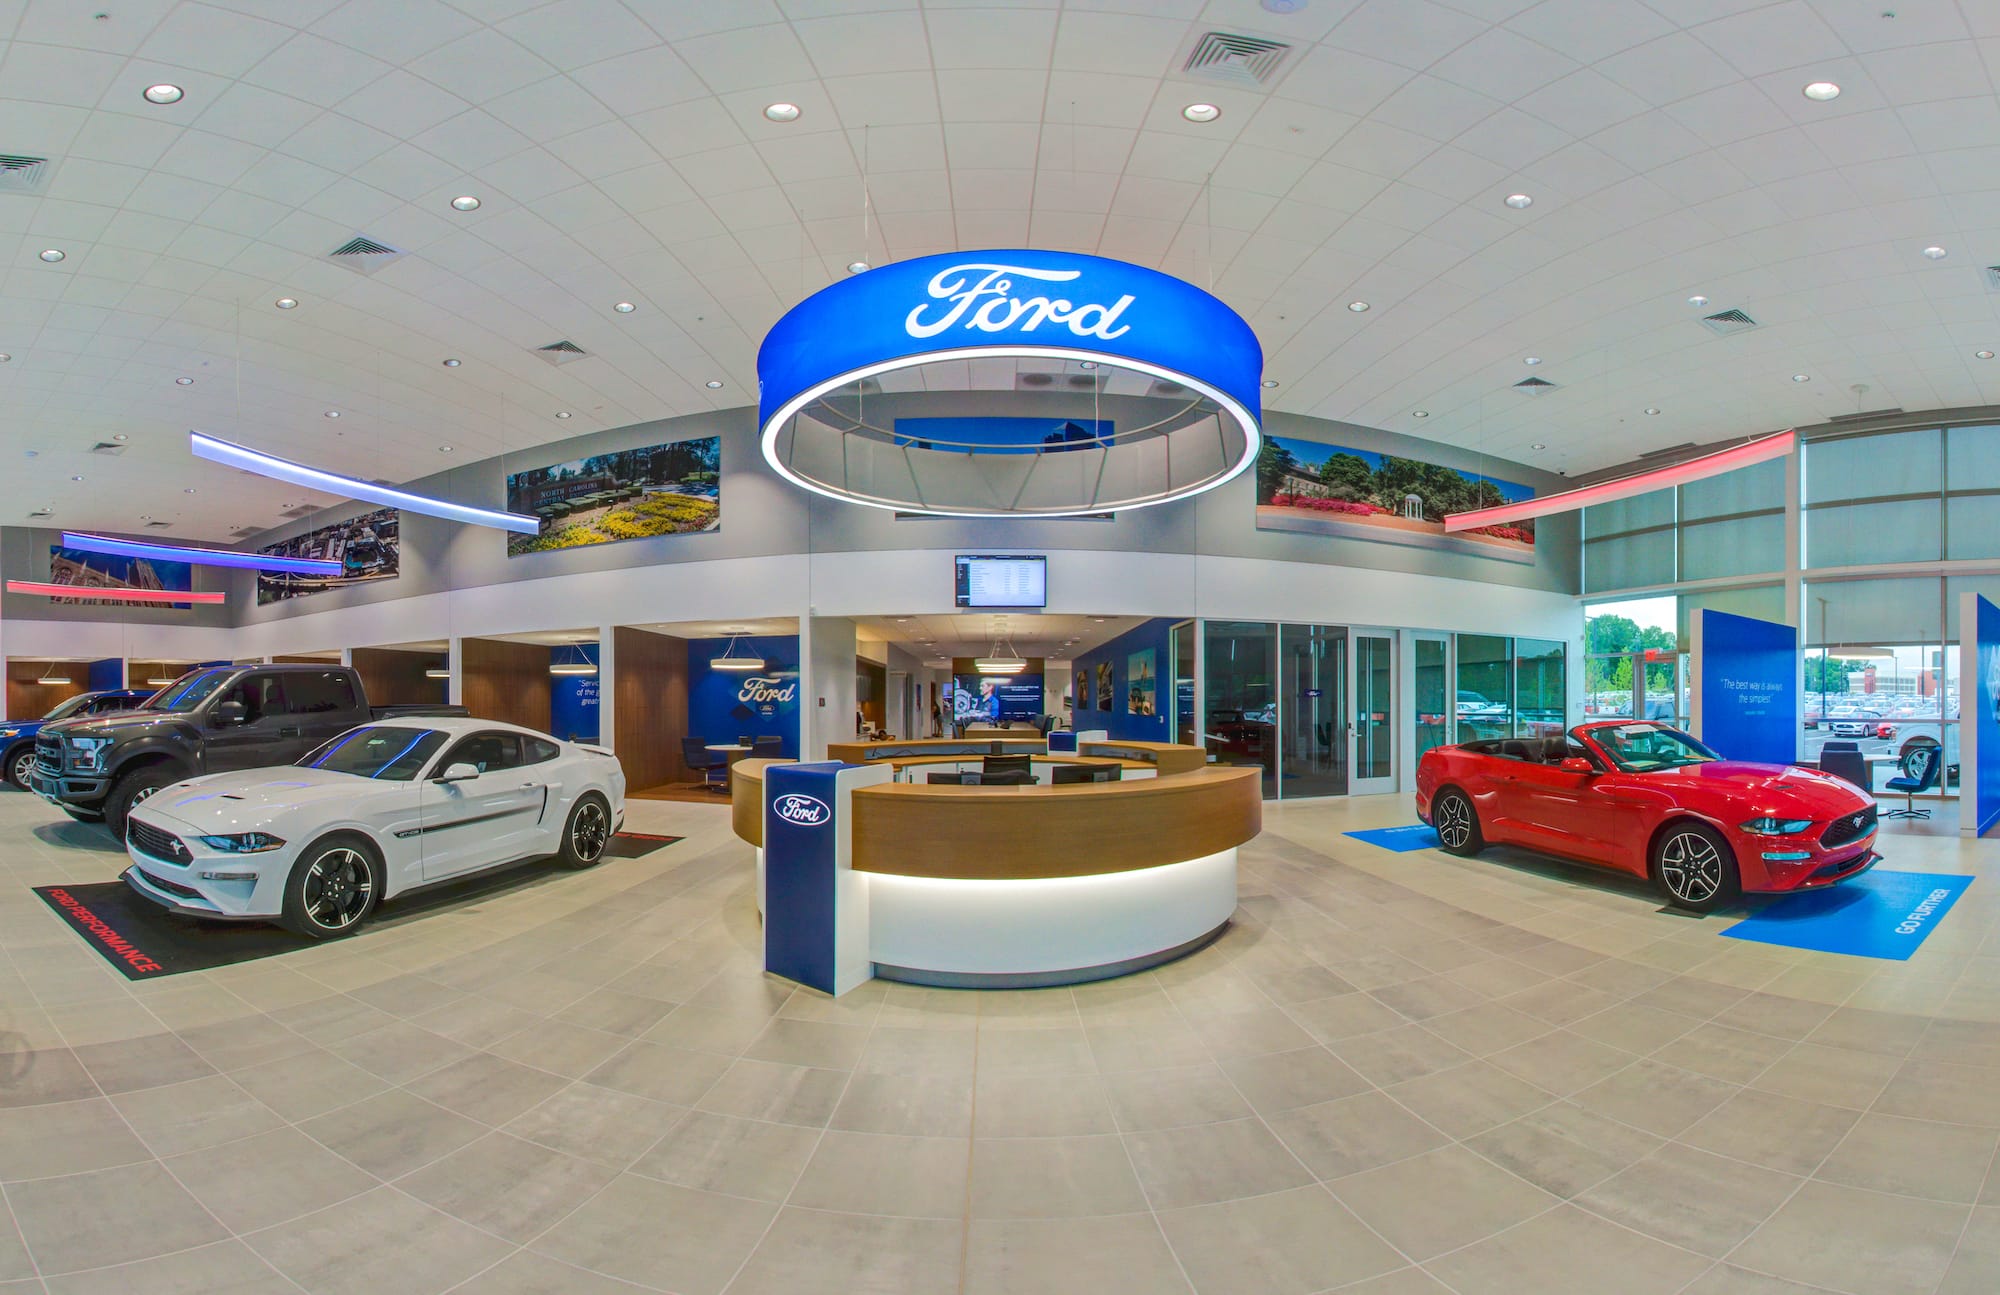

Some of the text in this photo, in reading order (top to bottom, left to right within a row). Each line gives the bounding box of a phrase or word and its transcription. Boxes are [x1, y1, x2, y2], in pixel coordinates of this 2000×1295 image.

[905, 263, 1136, 340] Ford
[540, 488, 565, 498] NORTH
[738, 677, 796, 702] Ford
[1735, 680, 1748, 690] best
[782, 796, 820, 822] Ford
[1894, 888, 1952, 934] GO FURTHER
[48, 888, 163, 973] FORD PERFORMANCE
